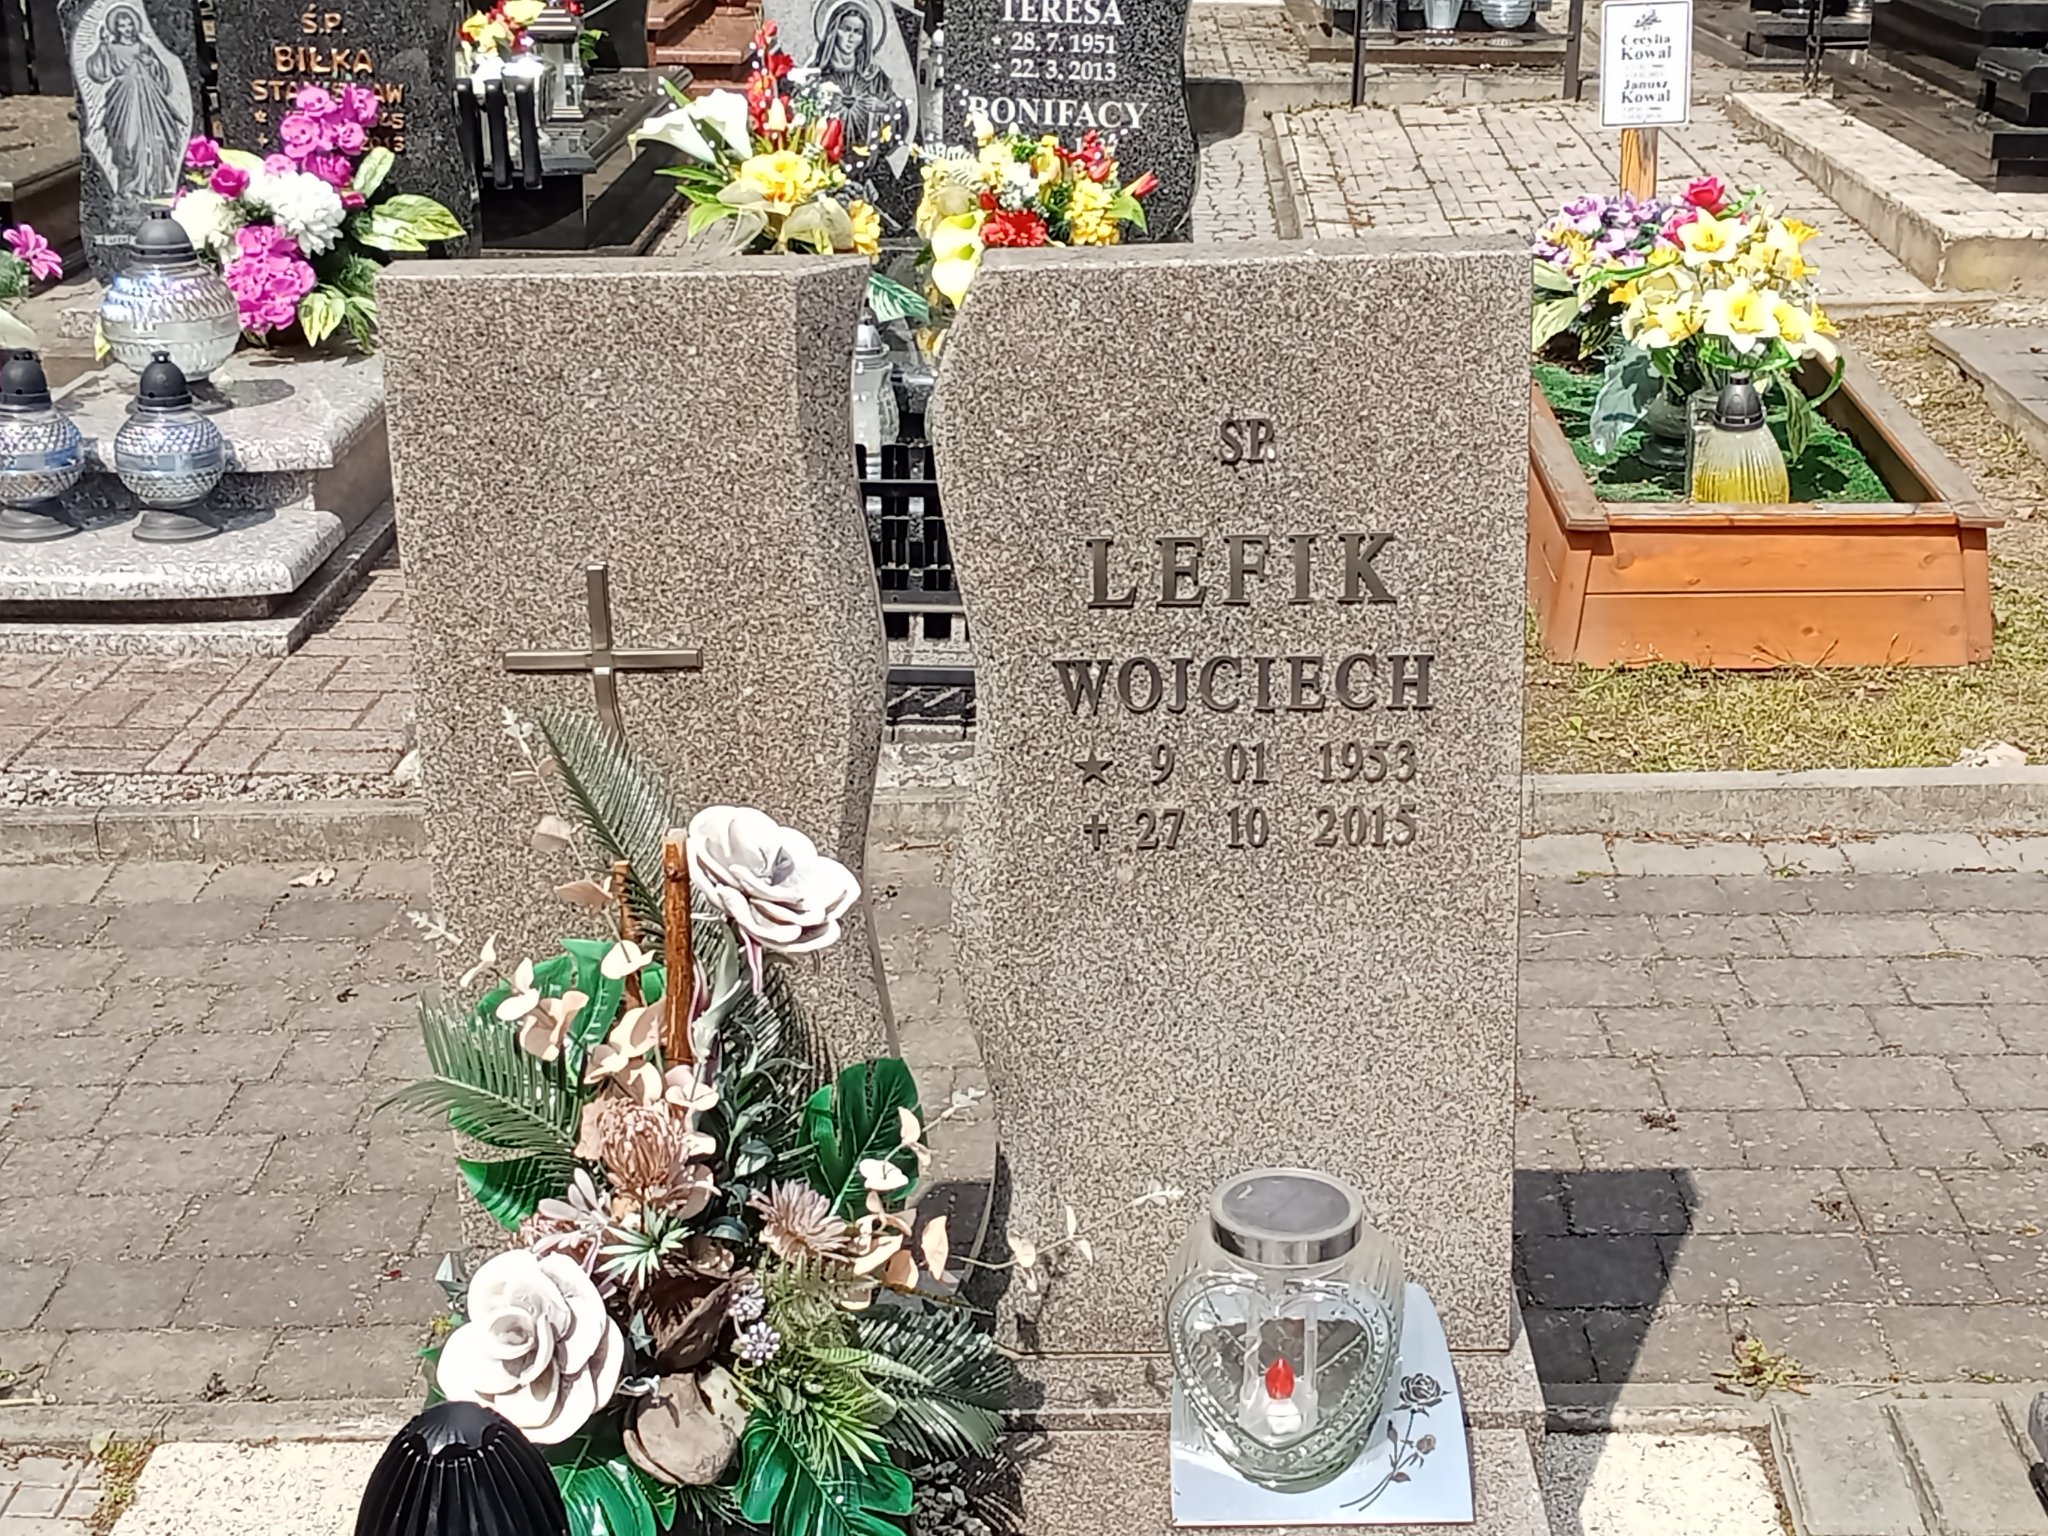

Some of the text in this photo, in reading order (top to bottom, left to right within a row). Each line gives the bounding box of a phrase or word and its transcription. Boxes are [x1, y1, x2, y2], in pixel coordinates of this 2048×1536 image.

[1001, 0, 1125, 25] TERESA
[1010, 31, 1118, 54] 28. 7. 1951
[1621, 34, 1671, 47] Cecylia
[1621, 45, 1671, 60] Kowal
[274, 46, 374, 74] BIŁKA
[1010, 58, 1118, 81] 22. 3. 2013
[1621, 89, 1671, 104] Kowal
[968, 96, 1149, 129] BONIFACY
[1086, 531, 1397, 608] LEFIK
[1052, 654, 1435, 715] WOJCIECH
[1150, 739, 1417, 784] 9 01 1953
[1135, 804, 1417, 849] 27 10 2015
